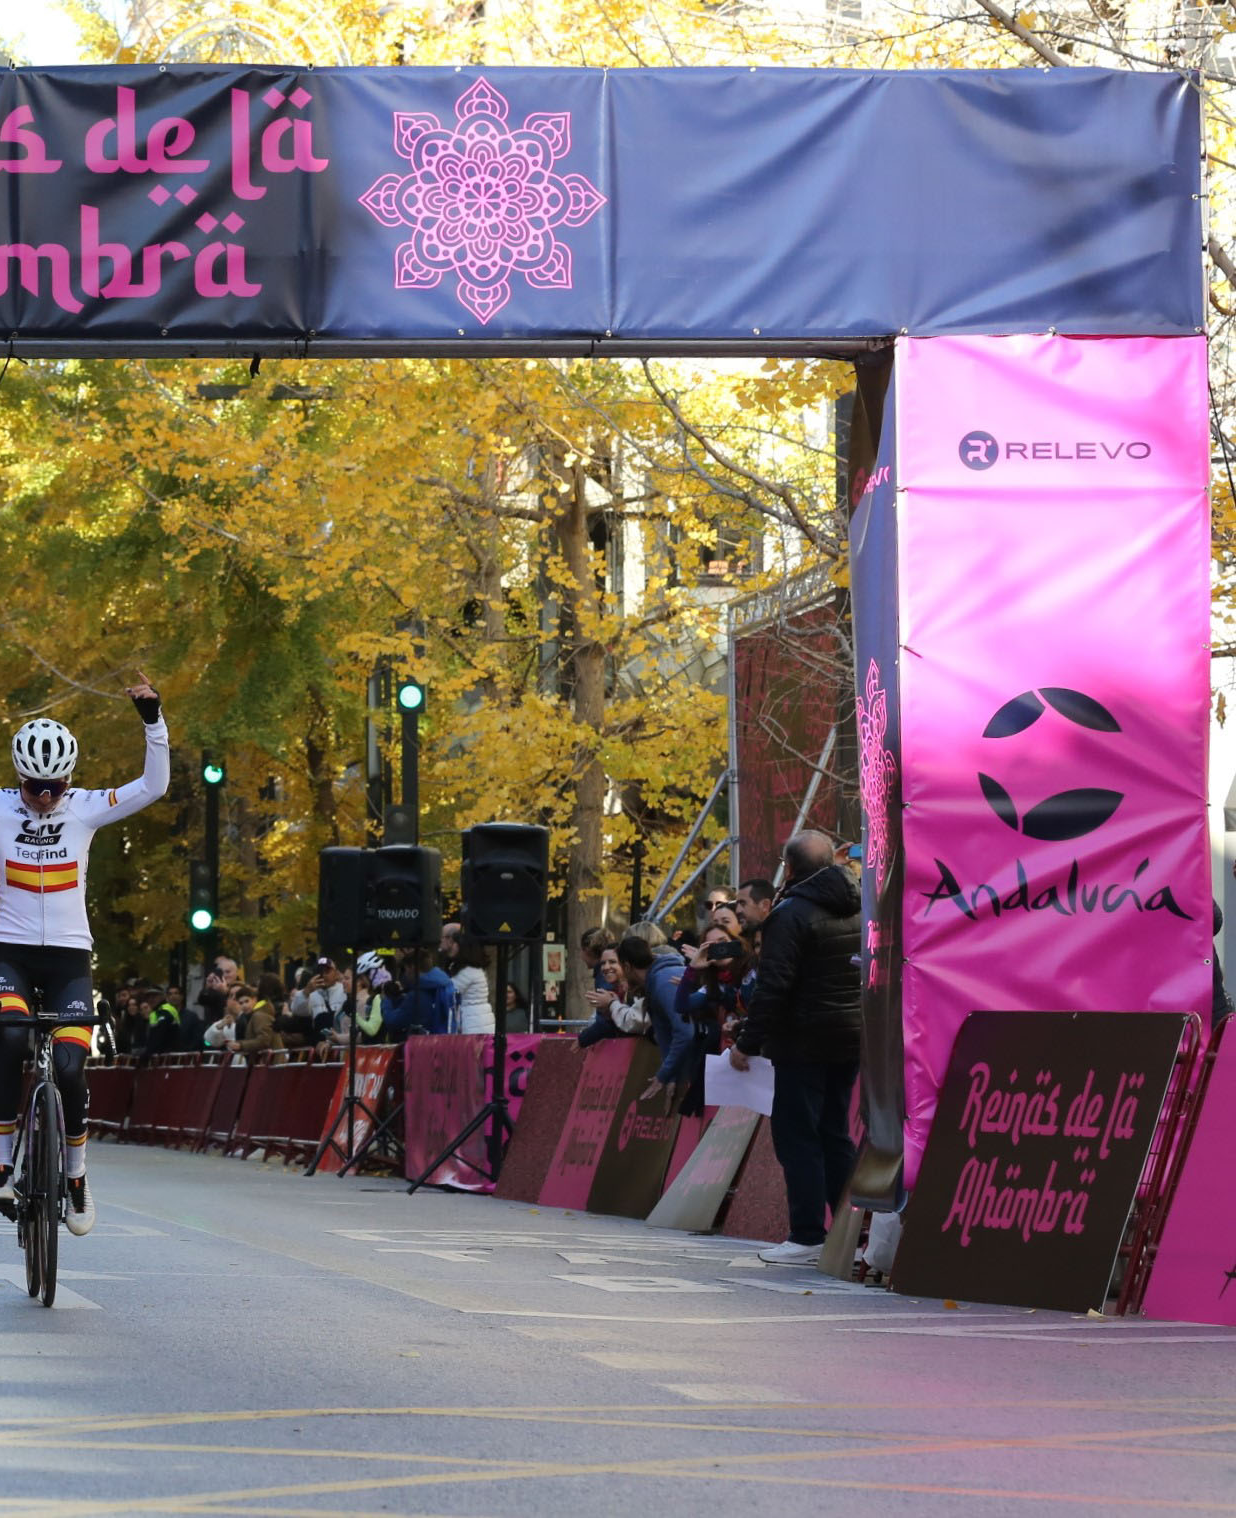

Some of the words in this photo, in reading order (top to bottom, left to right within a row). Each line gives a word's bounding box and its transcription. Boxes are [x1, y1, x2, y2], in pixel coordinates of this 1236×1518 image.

[1004, 441, 1153, 461] RELEVO
[920, 856, 1197, 922] Andalucía
[376, 908, 420, 920] TORNADO
